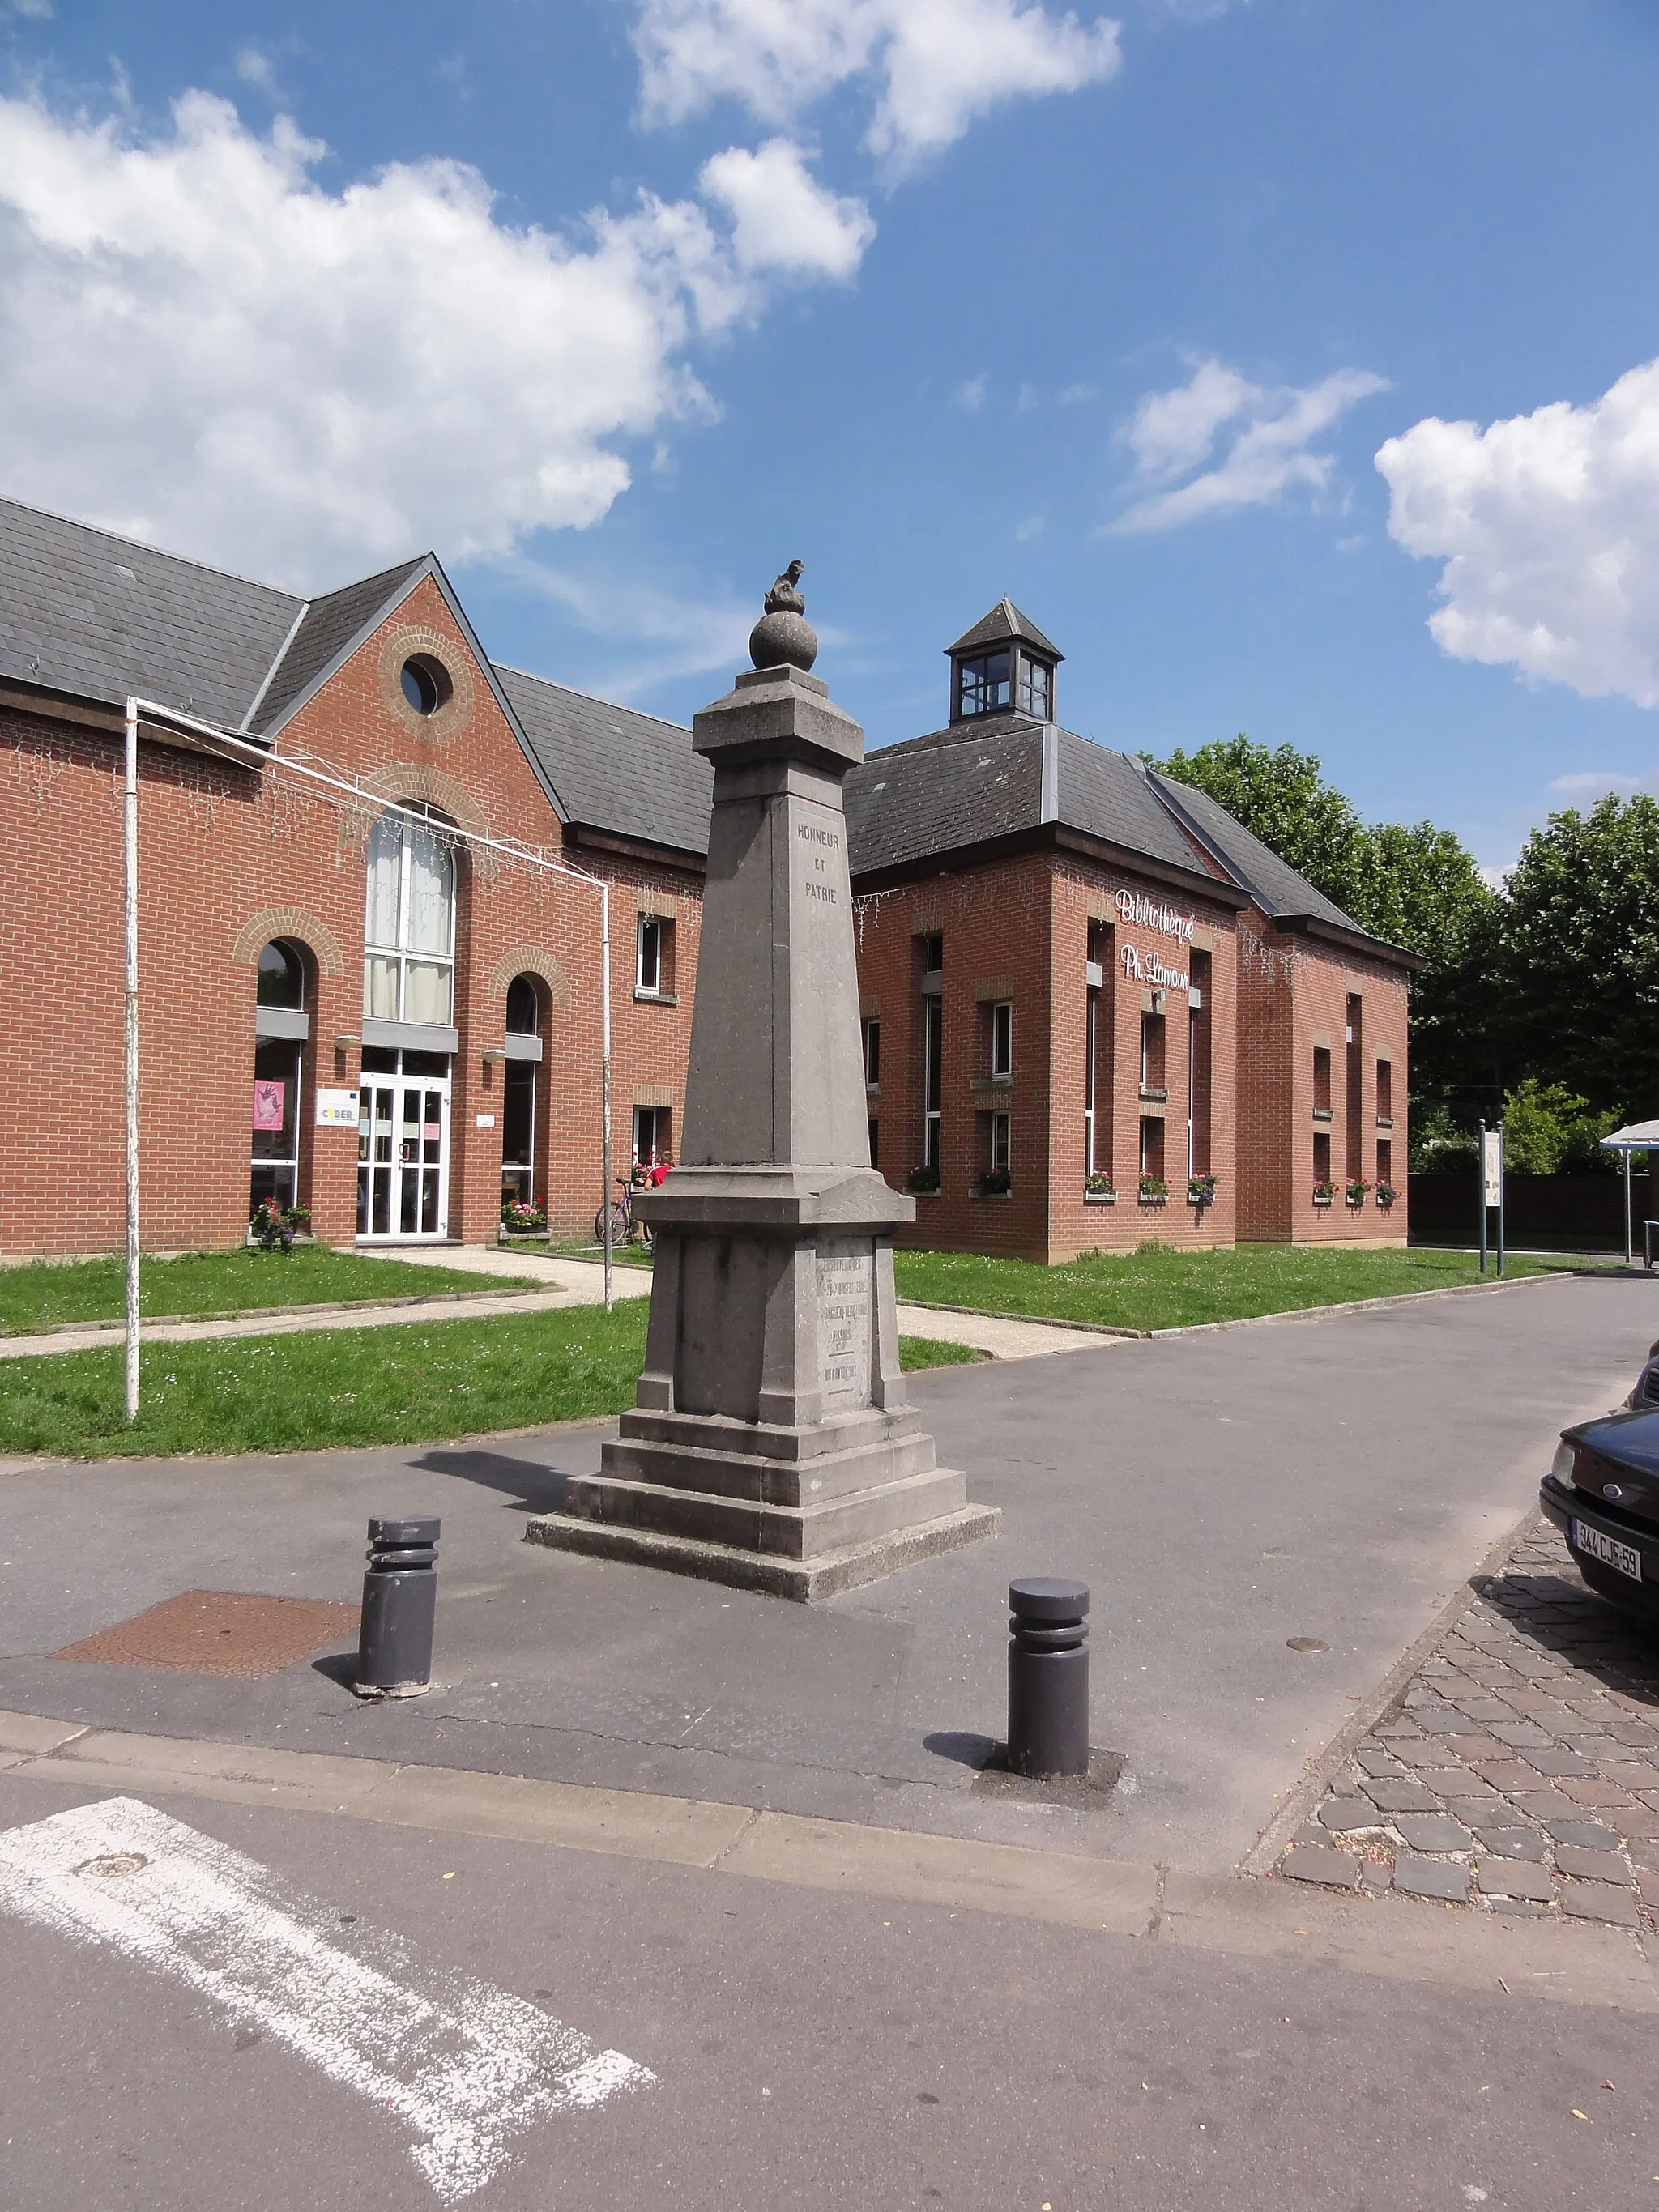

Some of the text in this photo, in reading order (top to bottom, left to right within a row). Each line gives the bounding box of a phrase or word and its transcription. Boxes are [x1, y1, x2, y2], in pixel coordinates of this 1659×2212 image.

[798, 824, 838, 849] HONNEUR
[814, 858, 825, 872] ET
[805, 882, 836, 903] PATRIE
[1115, 889, 1194, 944] Bibliothèque
[1145, 952, 1189, 990] Lamour
[1580, 1525, 1597, 1554] 344
[1623, 1548, 1636, 1575] 59
